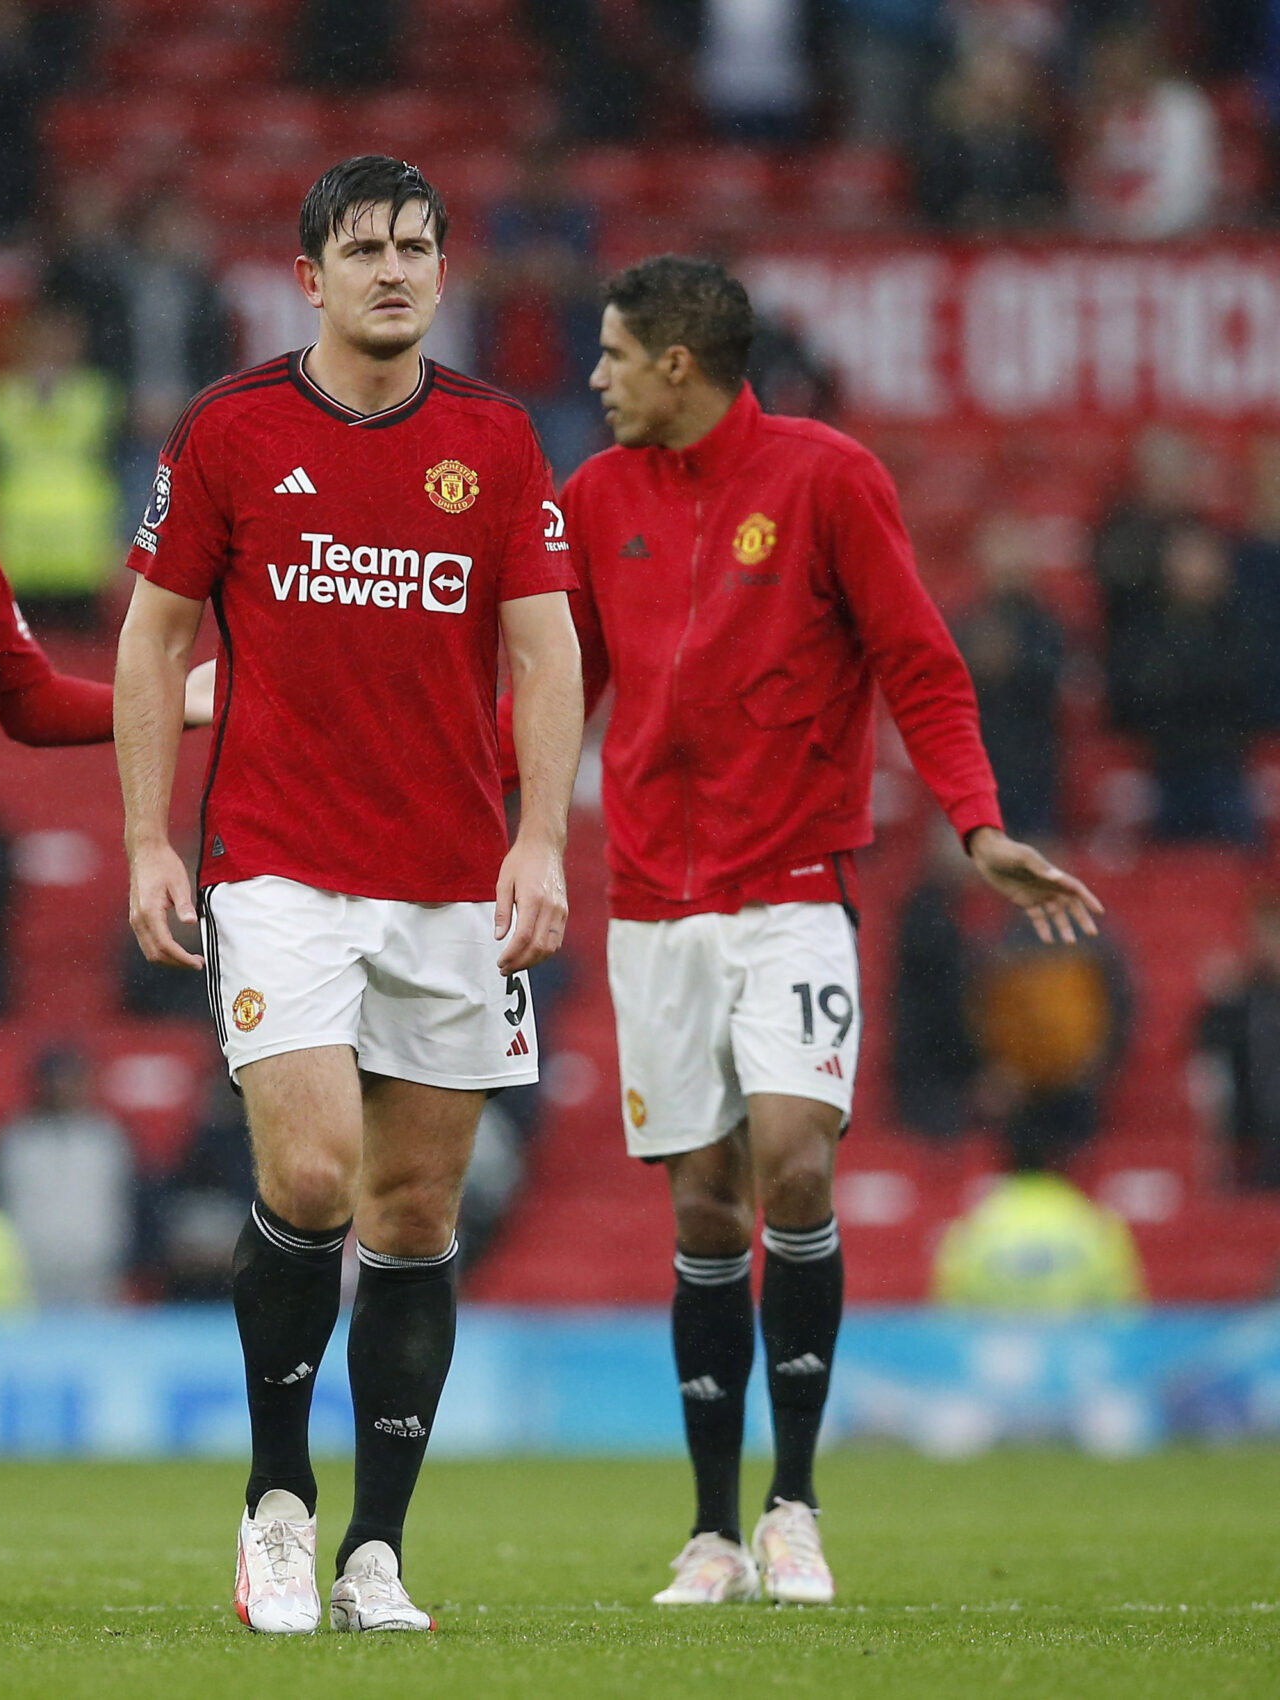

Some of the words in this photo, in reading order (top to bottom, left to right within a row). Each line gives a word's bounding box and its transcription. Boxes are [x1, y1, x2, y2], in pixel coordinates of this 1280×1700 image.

[430, 463, 474, 481] MANCHESTER
[438, 499, 468, 510] UNITED
[300, 532, 420, 578] Team
[267, 563, 418, 609] Viewer
[504, 973, 527, 1026] 5
[792, 983, 853, 1049] 19
[374, 1421, 426, 1438] adidas
